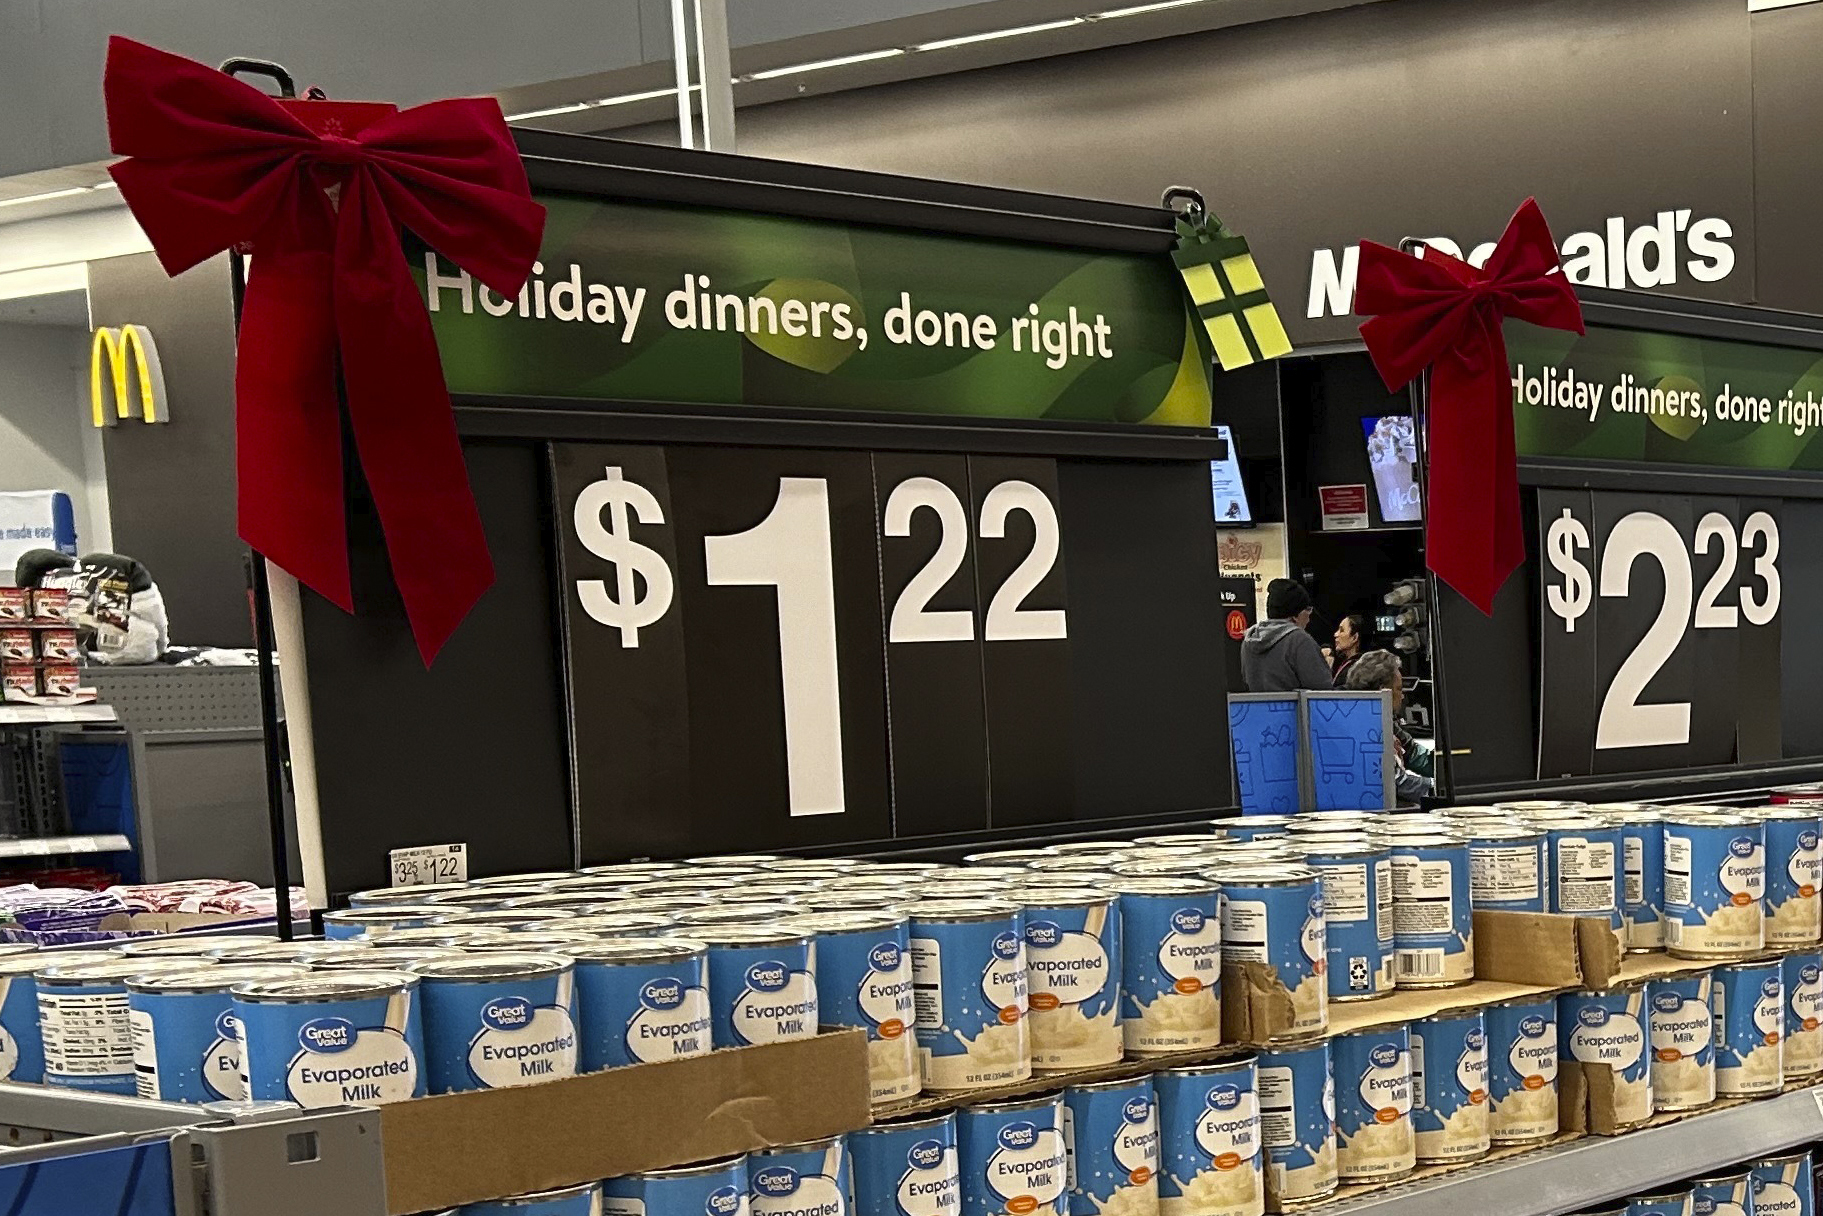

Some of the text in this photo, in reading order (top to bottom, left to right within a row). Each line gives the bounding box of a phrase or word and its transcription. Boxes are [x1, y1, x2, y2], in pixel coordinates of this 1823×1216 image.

[664, 272, 868, 351] dinners,
[884, 291, 997, 351] done
[1012, 308, 1113, 370] right
[1610, 373, 1709, 426] dinners,
[1715, 383, 1772, 423] done
[751, 967, 785, 984] Great
[1047, 972, 1078, 988] Milk
[646, 985, 680, 1000] Great
[487, 1004, 526, 1021] Great
[745, 1000, 817, 1022] Evaporated
[305, 1026, 348, 1040] Great
[777, 1018, 804, 1035] Milk
[1650, 1018, 1709, 1035] Evaporated
[673, 1035, 700, 1055] Milk
[1576, 1029, 1640, 1049] Evaporated
[1673, 1030, 1696, 1044] Milk
[482, 1034, 573, 1062] Evaporated
[1598, 1044, 1622, 1059] Milk
[301, 1056, 410, 1086] Evaporated
[520, 1058, 554, 1077] Milk
[342, 1084, 382, 1102] Milk
[758, 1173, 793, 1189] Great
[1027, 1172, 1052, 1187] Milk
